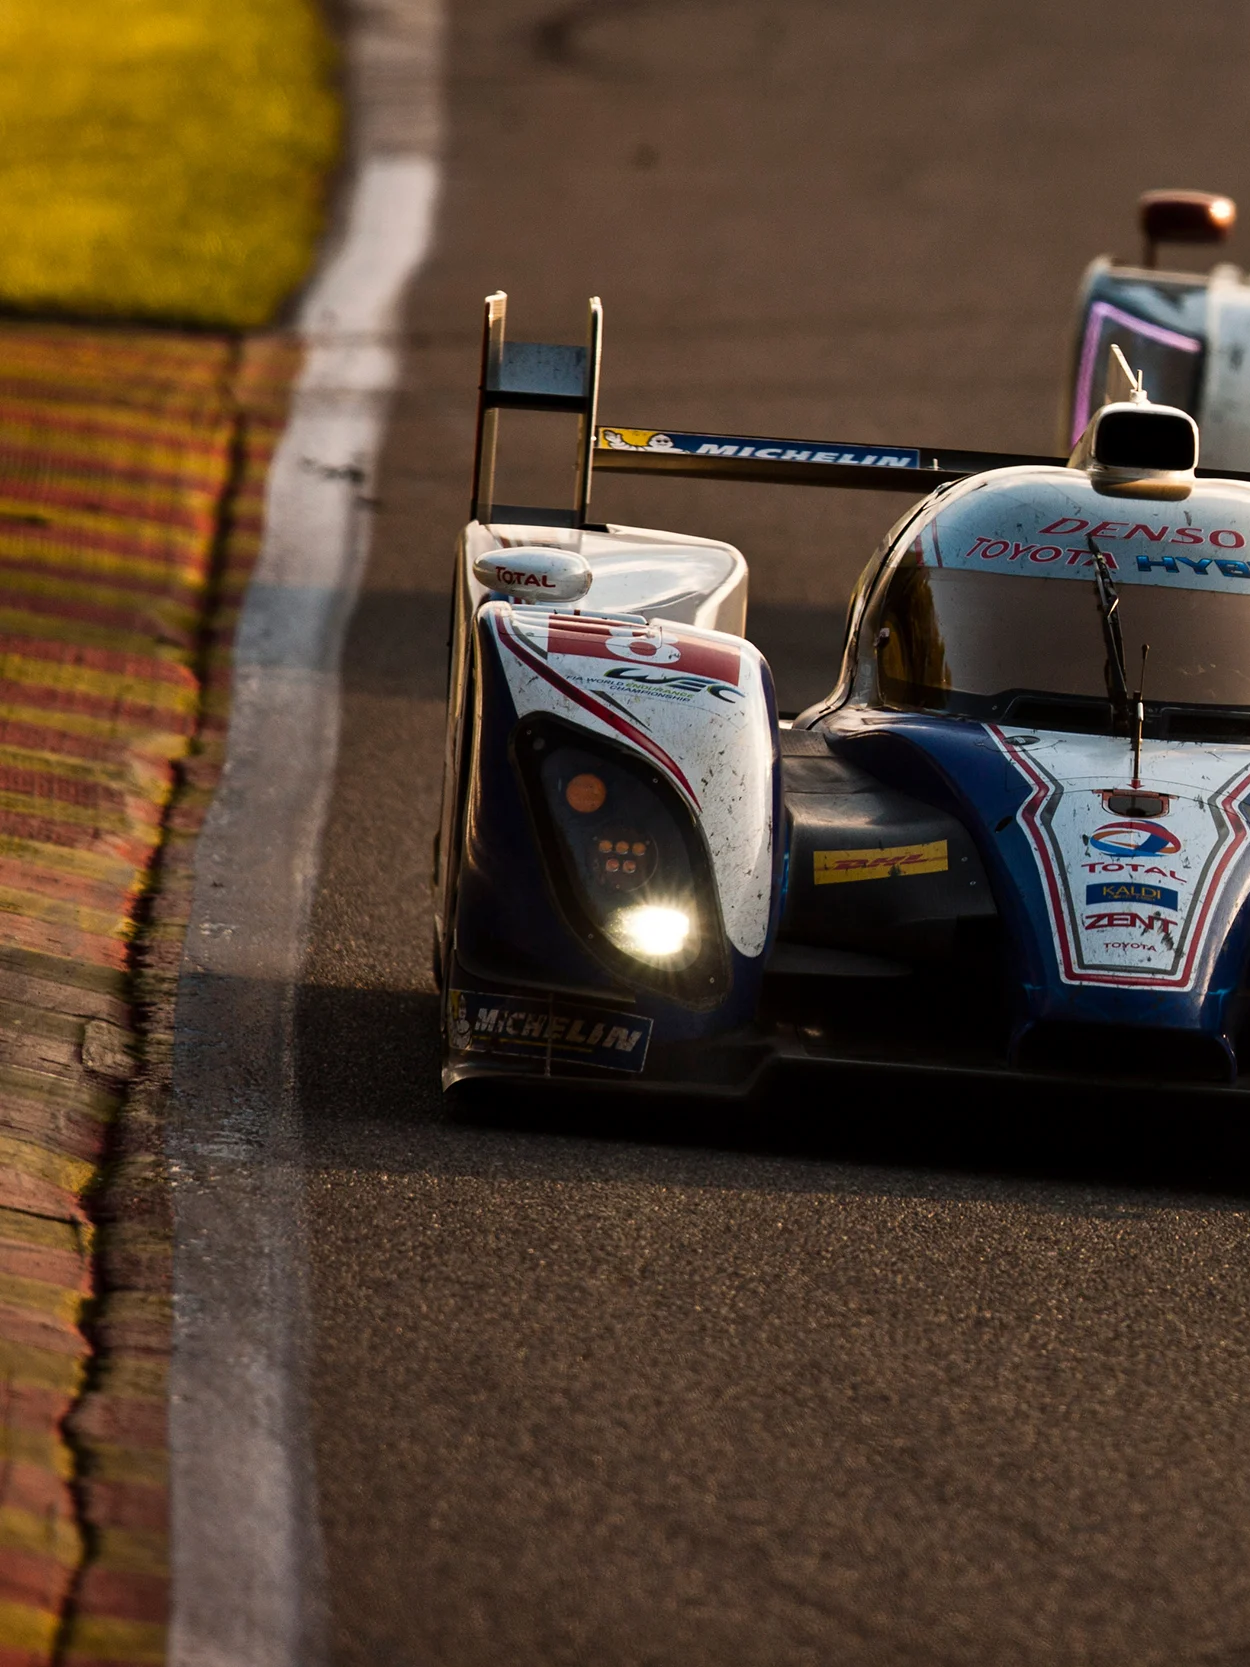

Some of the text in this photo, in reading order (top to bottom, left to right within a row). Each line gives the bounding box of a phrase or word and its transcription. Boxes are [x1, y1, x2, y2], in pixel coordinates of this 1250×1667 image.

[696, 443, 911, 467] MICHELIN
[1040, 517, 1245, 549] DENSO
[966, 536, 1117, 570] TOYOTA
[495, 566, 556, 587] TOTAL
[567, 674, 695, 699] FIA WORLD ENDURANCE
[603, 667, 745, 703] WEC
[609, 685, 691, 702] CHAMPIONSHIP
[832, 854, 927, 870] DHL
[1081, 862, 1187, 883] TOTAL
[1102, 886, 1162, 899] KALDI
[1085, 912, 1178, 934] ZENT
[1104, 942, 1157, 952] TOYOTA
[474, 1008, 643, 1051] MICHELIN
